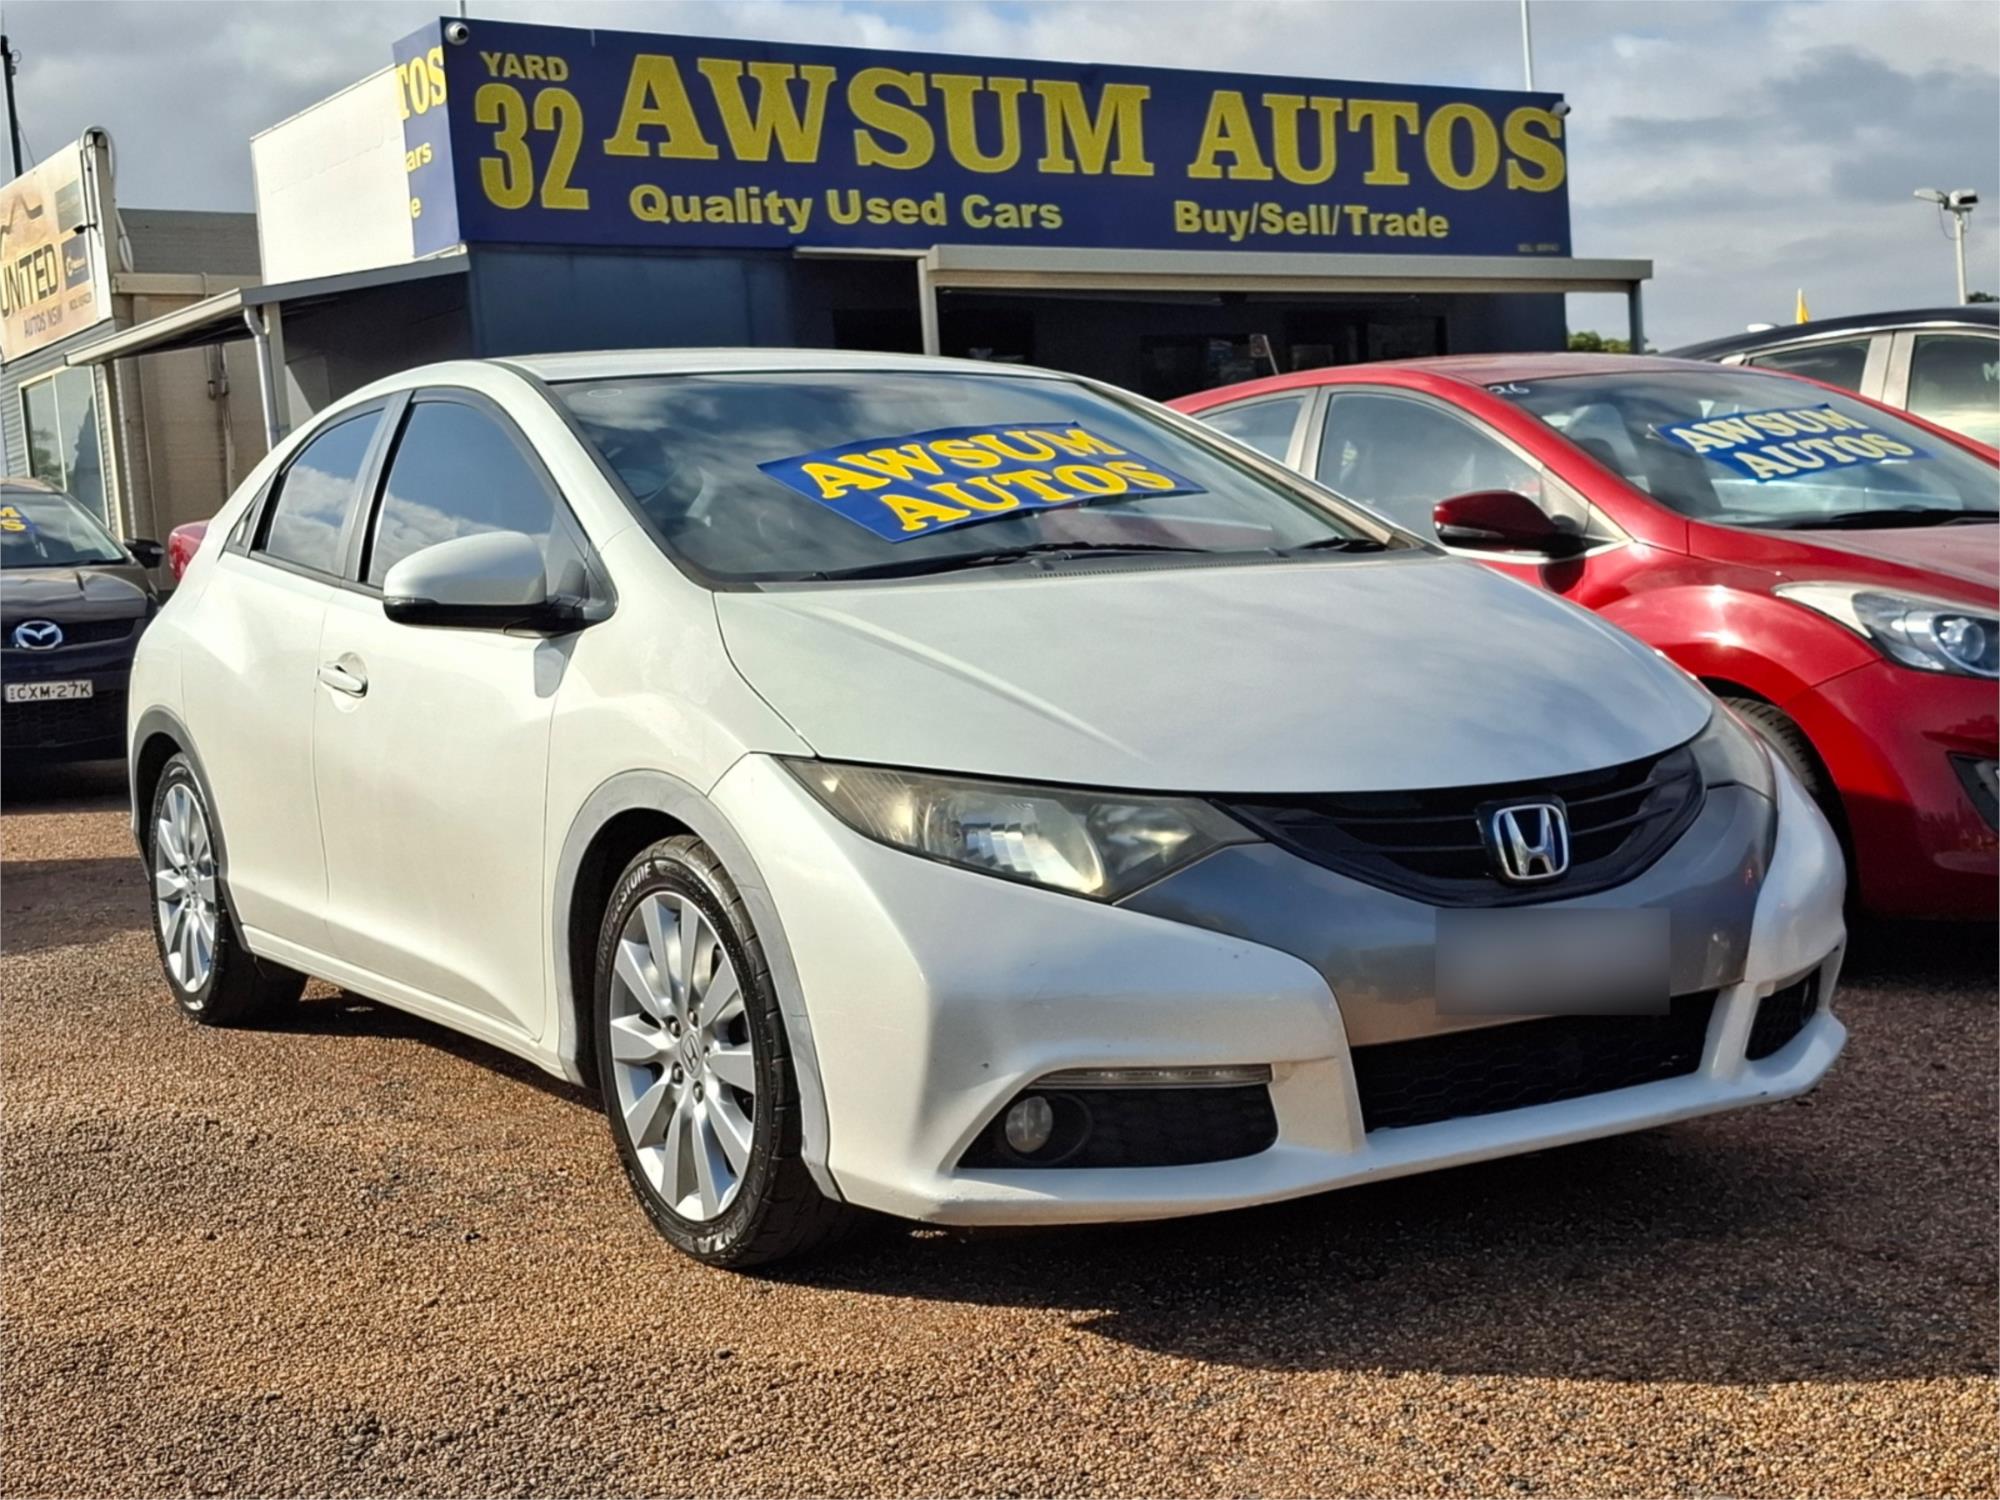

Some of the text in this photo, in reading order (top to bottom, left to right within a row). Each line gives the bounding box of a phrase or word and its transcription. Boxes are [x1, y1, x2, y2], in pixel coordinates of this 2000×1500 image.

[480, 51, 569, 81] YARD
[474, 82, 590, 210] 32
[603, 53, 1566, 193] AWSUM AUTOS
[629, 184, 1064, 234] Quality Used Cars
[1671, 408, 1870, 453] AWSUM
[1733, 433, 1915, 480] AUTOS
[801, 429, 1128, 499] AWSUM
[879, 461, 1176, 532] AUTOS
